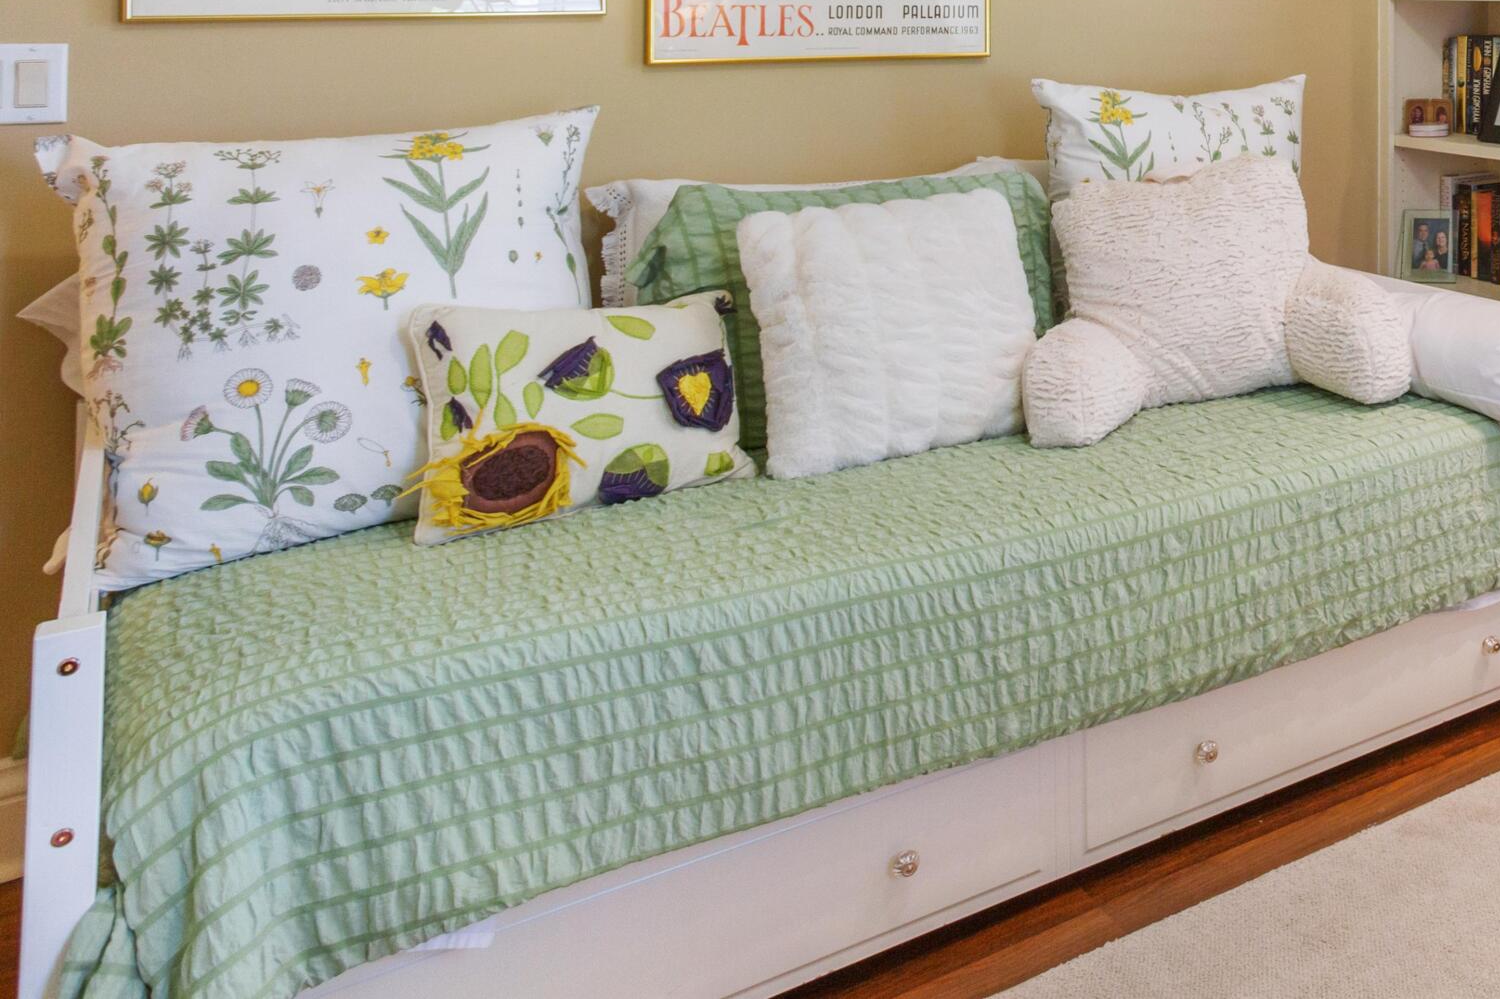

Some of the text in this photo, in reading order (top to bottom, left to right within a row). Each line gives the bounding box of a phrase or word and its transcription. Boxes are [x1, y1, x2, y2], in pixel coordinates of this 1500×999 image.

[828, 4, 979, 20] LONDON PALLADIUM
[828, 26, 853, 36] ROYAL
[855, 26, 898, 36] COMMAND
[901, 25, 960, 36] PERFORMANCE
